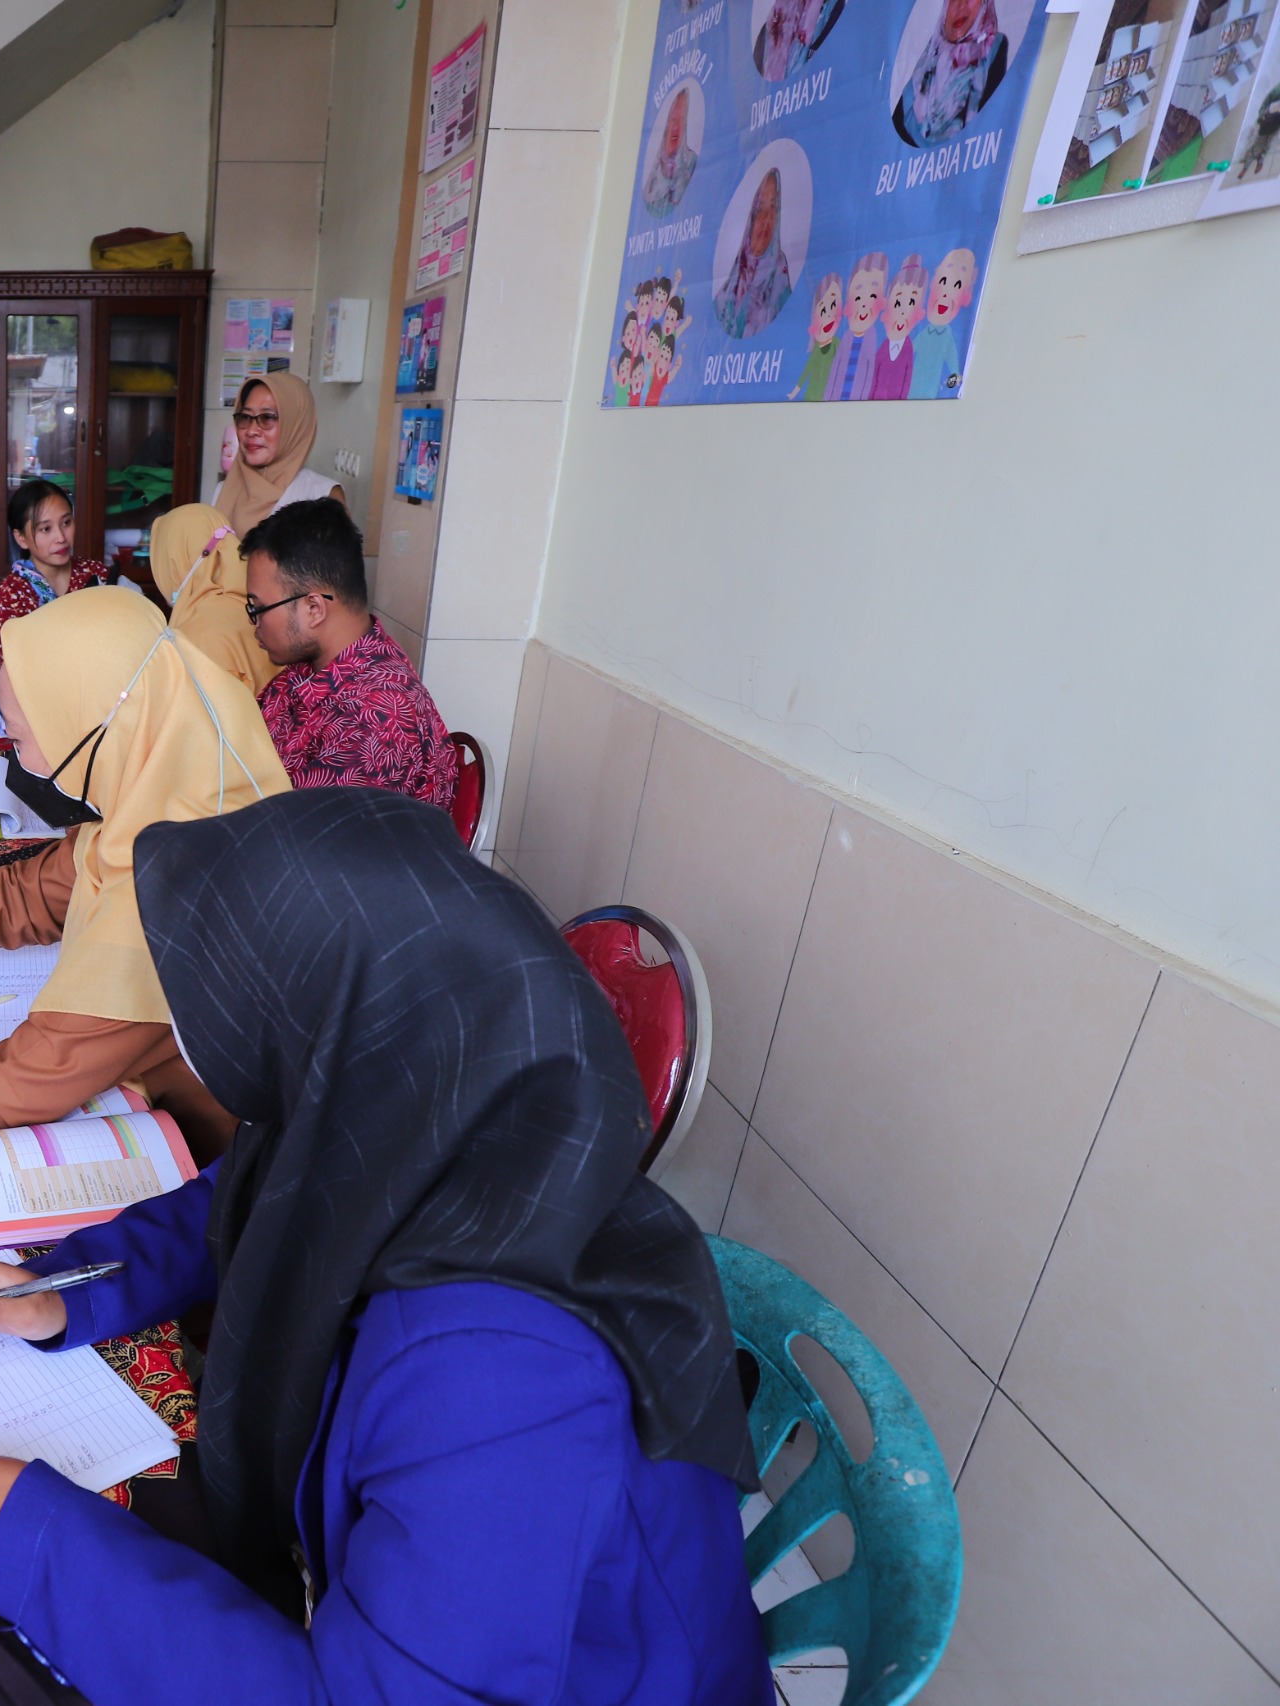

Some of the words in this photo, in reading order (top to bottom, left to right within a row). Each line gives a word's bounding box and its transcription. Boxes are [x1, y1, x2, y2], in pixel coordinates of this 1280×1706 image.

[690, 0, 723, 40] WAHYU
[654, 48, 707, 109] BENDAHARA
[750, 94, 772, 131] DWI
[772, 67, 832, 120] RAHAYU
[875, 160, 902, 196] BU
[906, 128, 1003, 189] WARIATUN
[627, 233, 655, 258] YUNITA
[657, 214, 703, 250] WIDYASARI
[703, 353, 723, 386] BU
[722, 349, 783, 384] SOLIKAH
